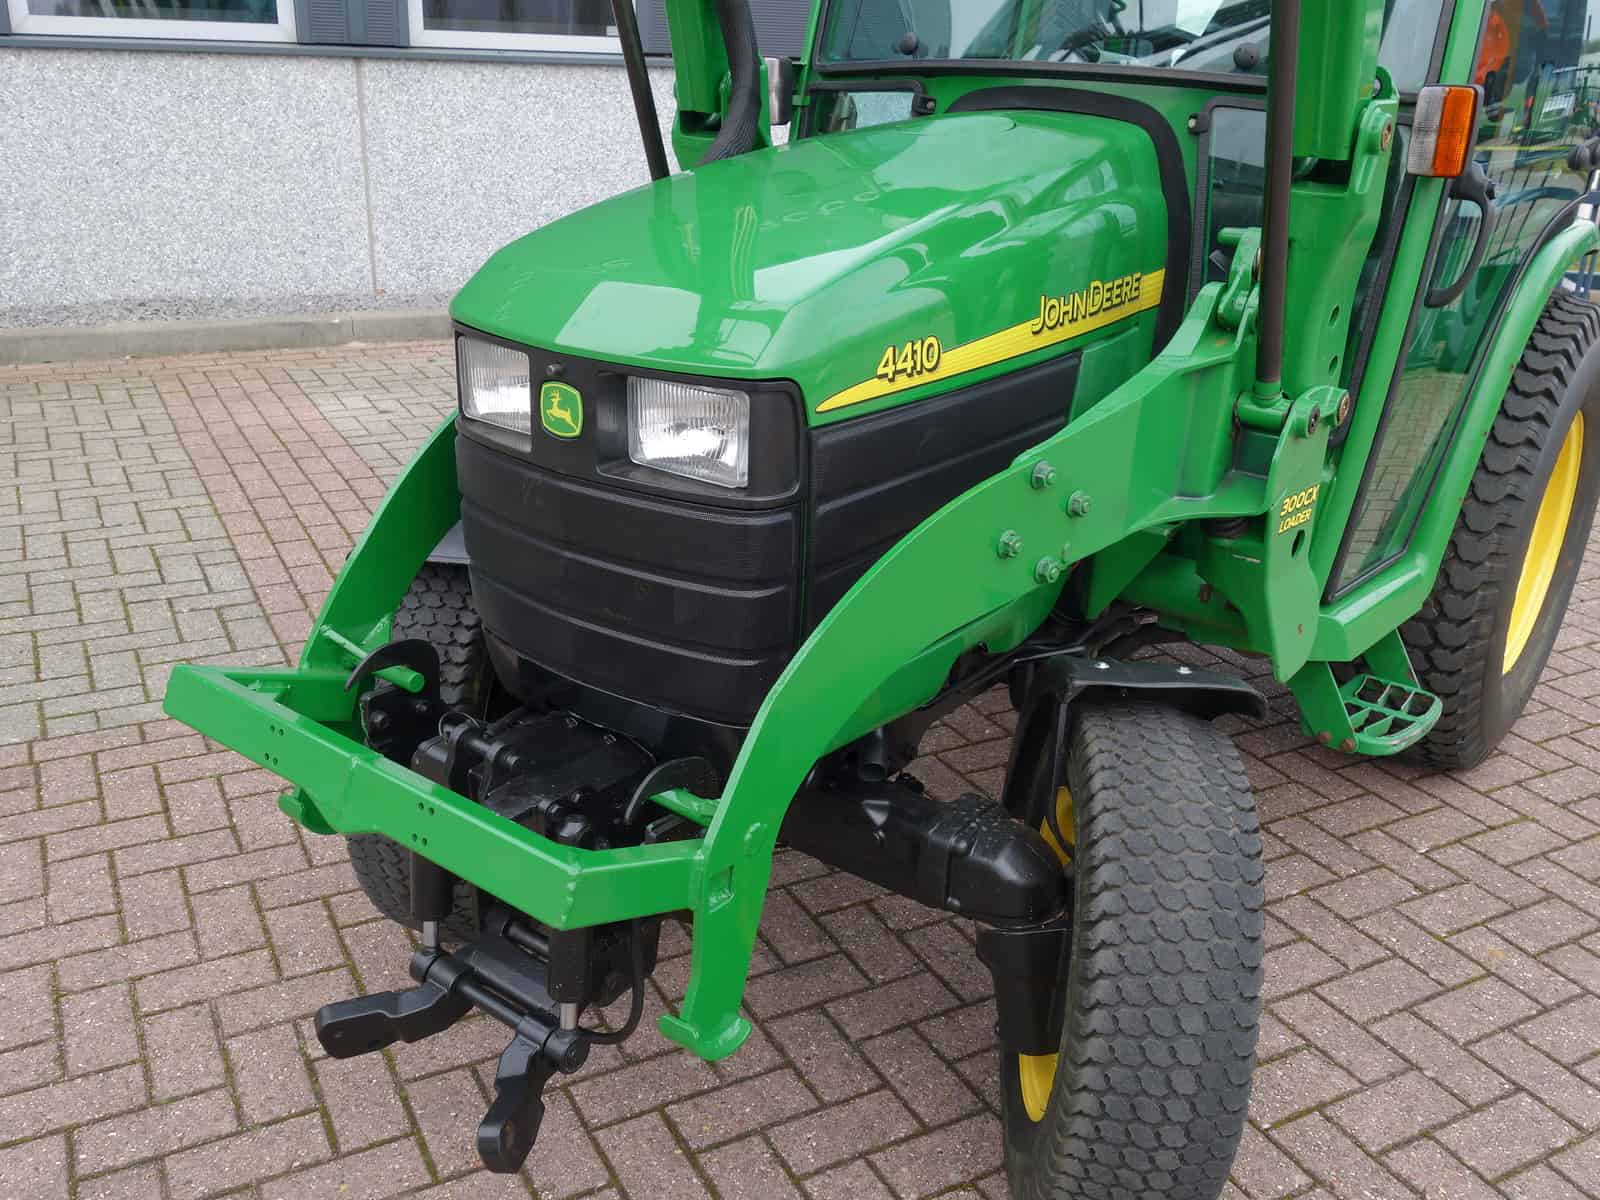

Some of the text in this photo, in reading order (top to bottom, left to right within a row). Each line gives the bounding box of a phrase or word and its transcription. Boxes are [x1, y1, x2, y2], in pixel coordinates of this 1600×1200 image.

[1031, 272, 1142, 334] JOHN DEERE
[877, 335, 941, 382] 4410
[1278, 508, 1312, 535] LOADER
